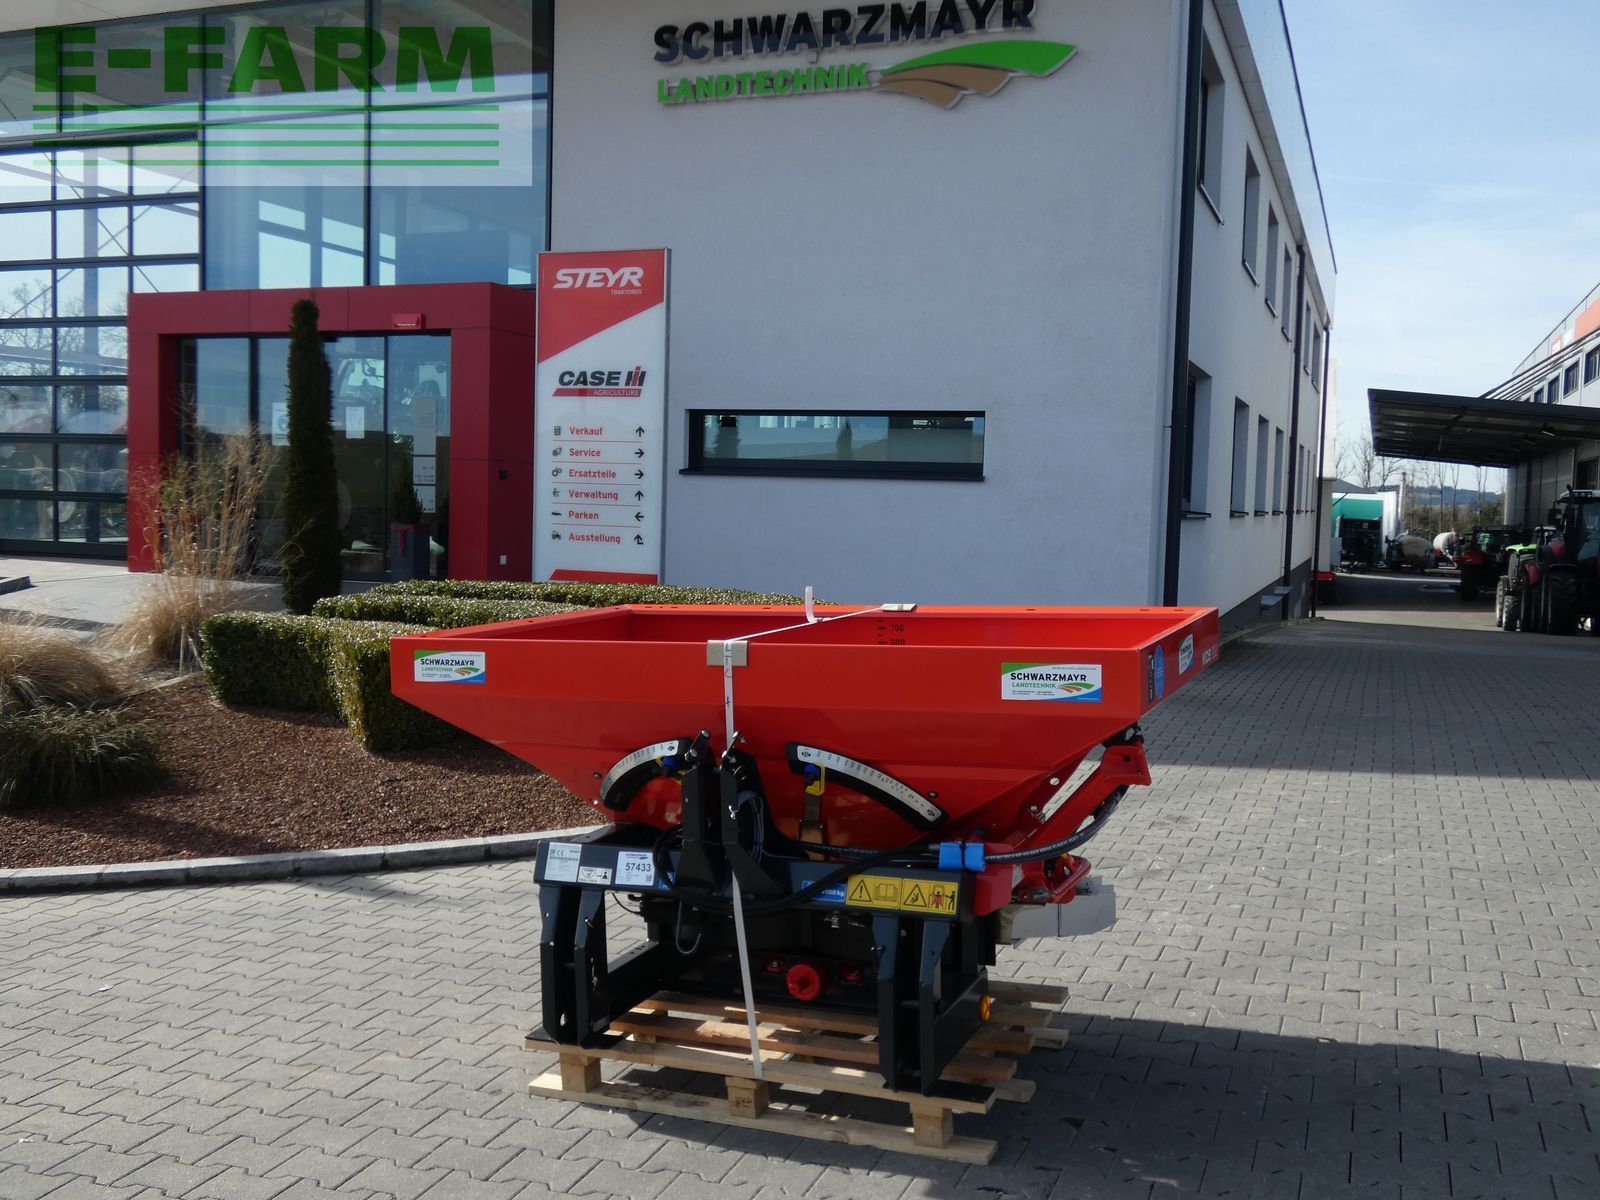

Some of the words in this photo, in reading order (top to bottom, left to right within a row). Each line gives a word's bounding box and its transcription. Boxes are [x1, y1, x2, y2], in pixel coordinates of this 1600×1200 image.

[654, 0, 1035, 62] SCHWARZMAYR
[658, 63, 871, 104] LANDTECHNIK
[552, 266, 644, 288] STEYR
[558, 370, 621, 387] CASE
[569, 426, 603, 436] Verkauf
[569, 448, 601, 457] Service
[568, 469, 616, 479] Ersatzteile
[568, 489, 619, 500] Verwaltung
[568, 510, 599, 520] Parken
[568, 532, 621, 544] Ausstellung
[420, 658, 475, 666] SCHWARZMAYR
[1010, 672, 1087, 682] SCHWARZMAYR
[625, 862, 651, 872] 57433
